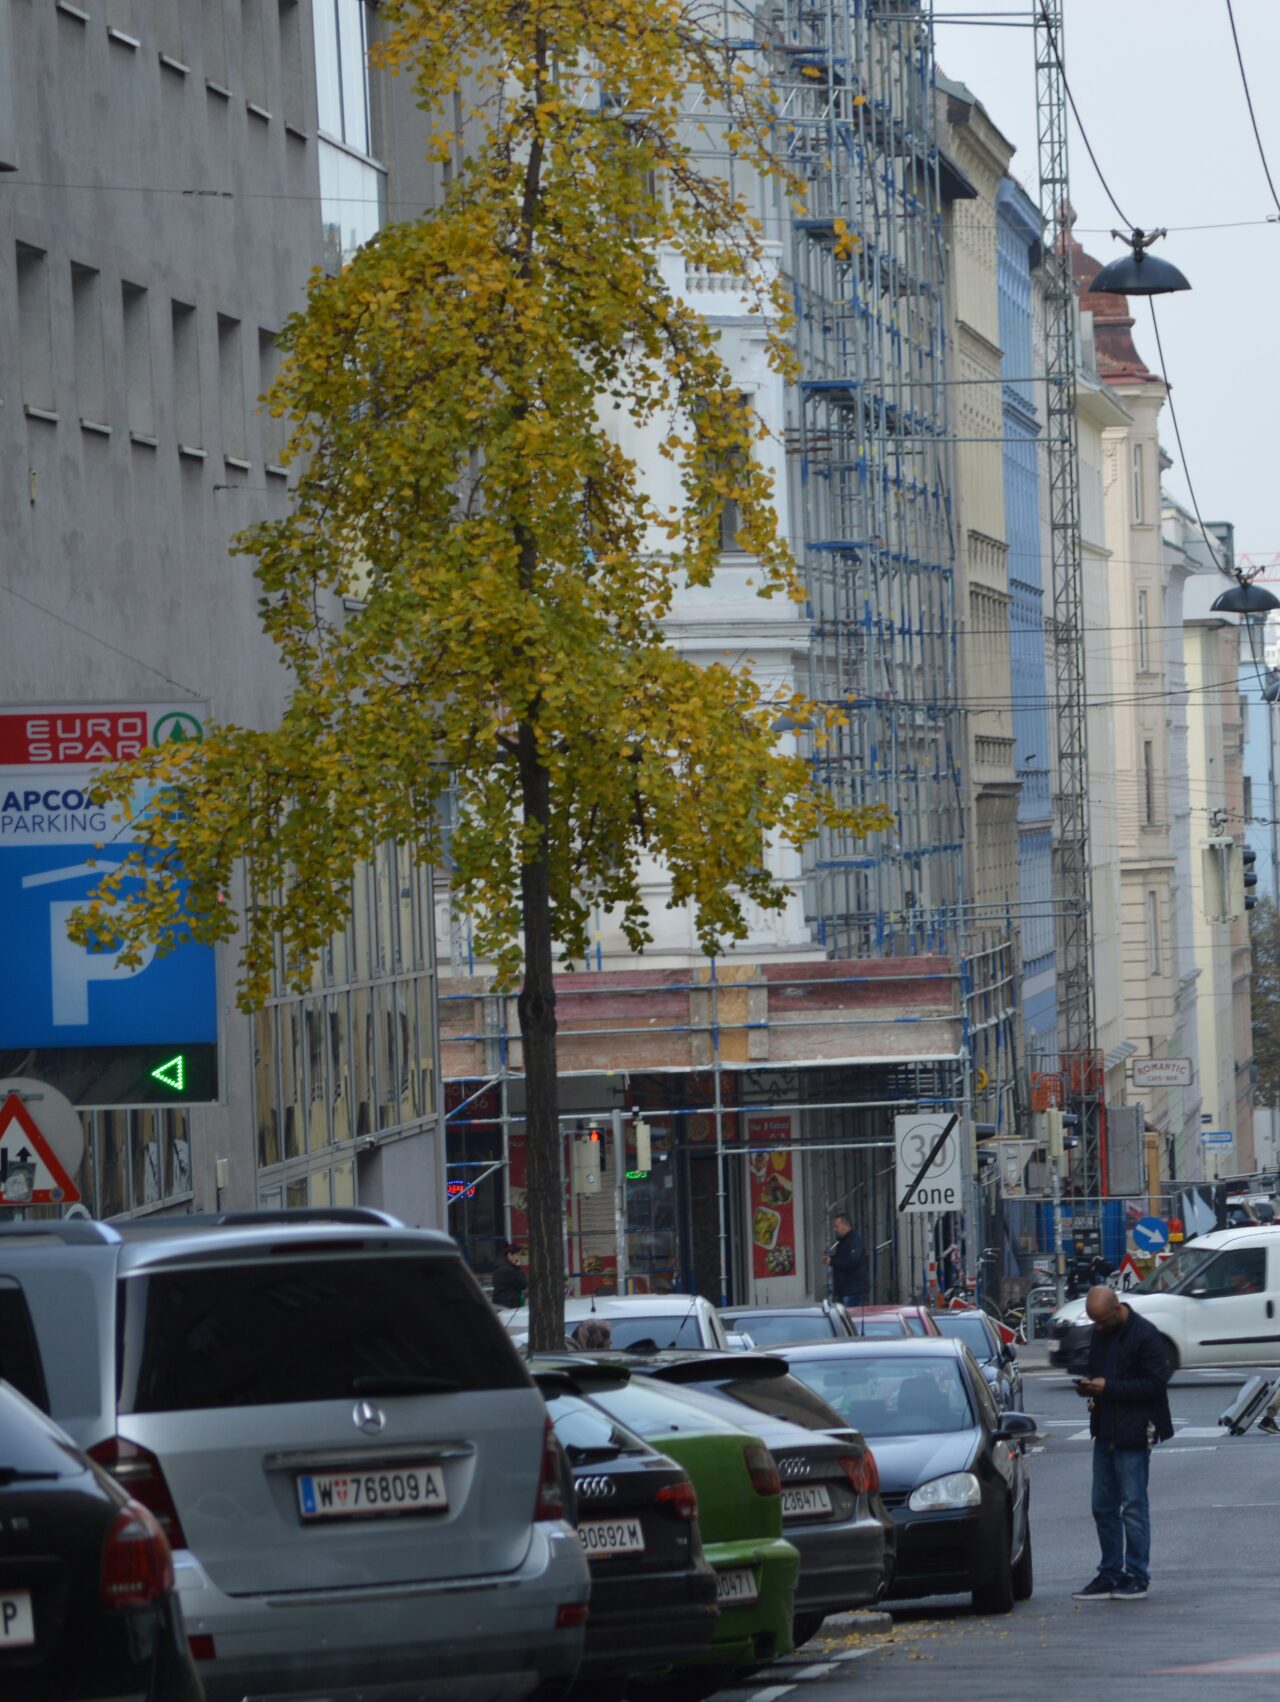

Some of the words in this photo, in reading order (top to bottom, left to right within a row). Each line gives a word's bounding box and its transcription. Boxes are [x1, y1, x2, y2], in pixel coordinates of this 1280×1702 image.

[26, 718, 142, 739] EURO
[28, 740, 142, 762] SPAR
[1, 789, 105, 813] APCOA
[1, 812, 106, 834] PARKING
[50, 900, 158, 1026] P
[1137, 1063, 1187, 1075] ROMANTIC
[910, 1133, 947, 1168] 30
[2, 1600, 17, 1636] P
